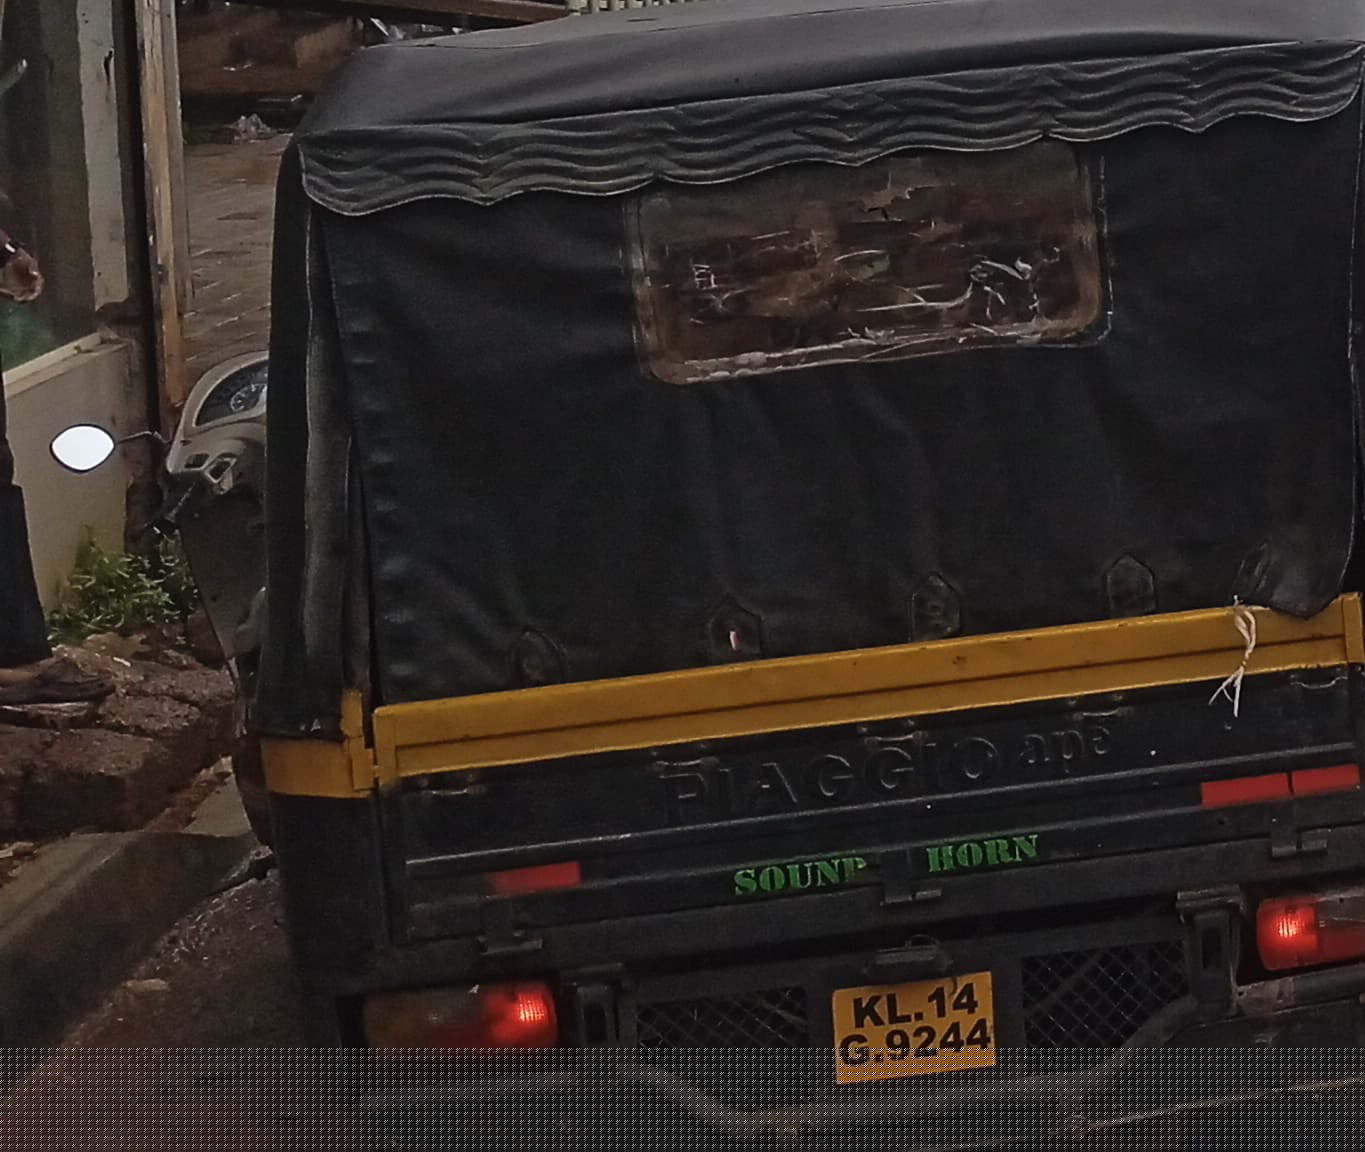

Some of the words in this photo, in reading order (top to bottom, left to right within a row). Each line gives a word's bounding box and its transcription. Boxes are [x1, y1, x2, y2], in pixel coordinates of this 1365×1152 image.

[926, 834, 1040, 873] HORN
[853, 982, 979, 1029] KL.14
[838, 1017, 991, 1066] G.9244
